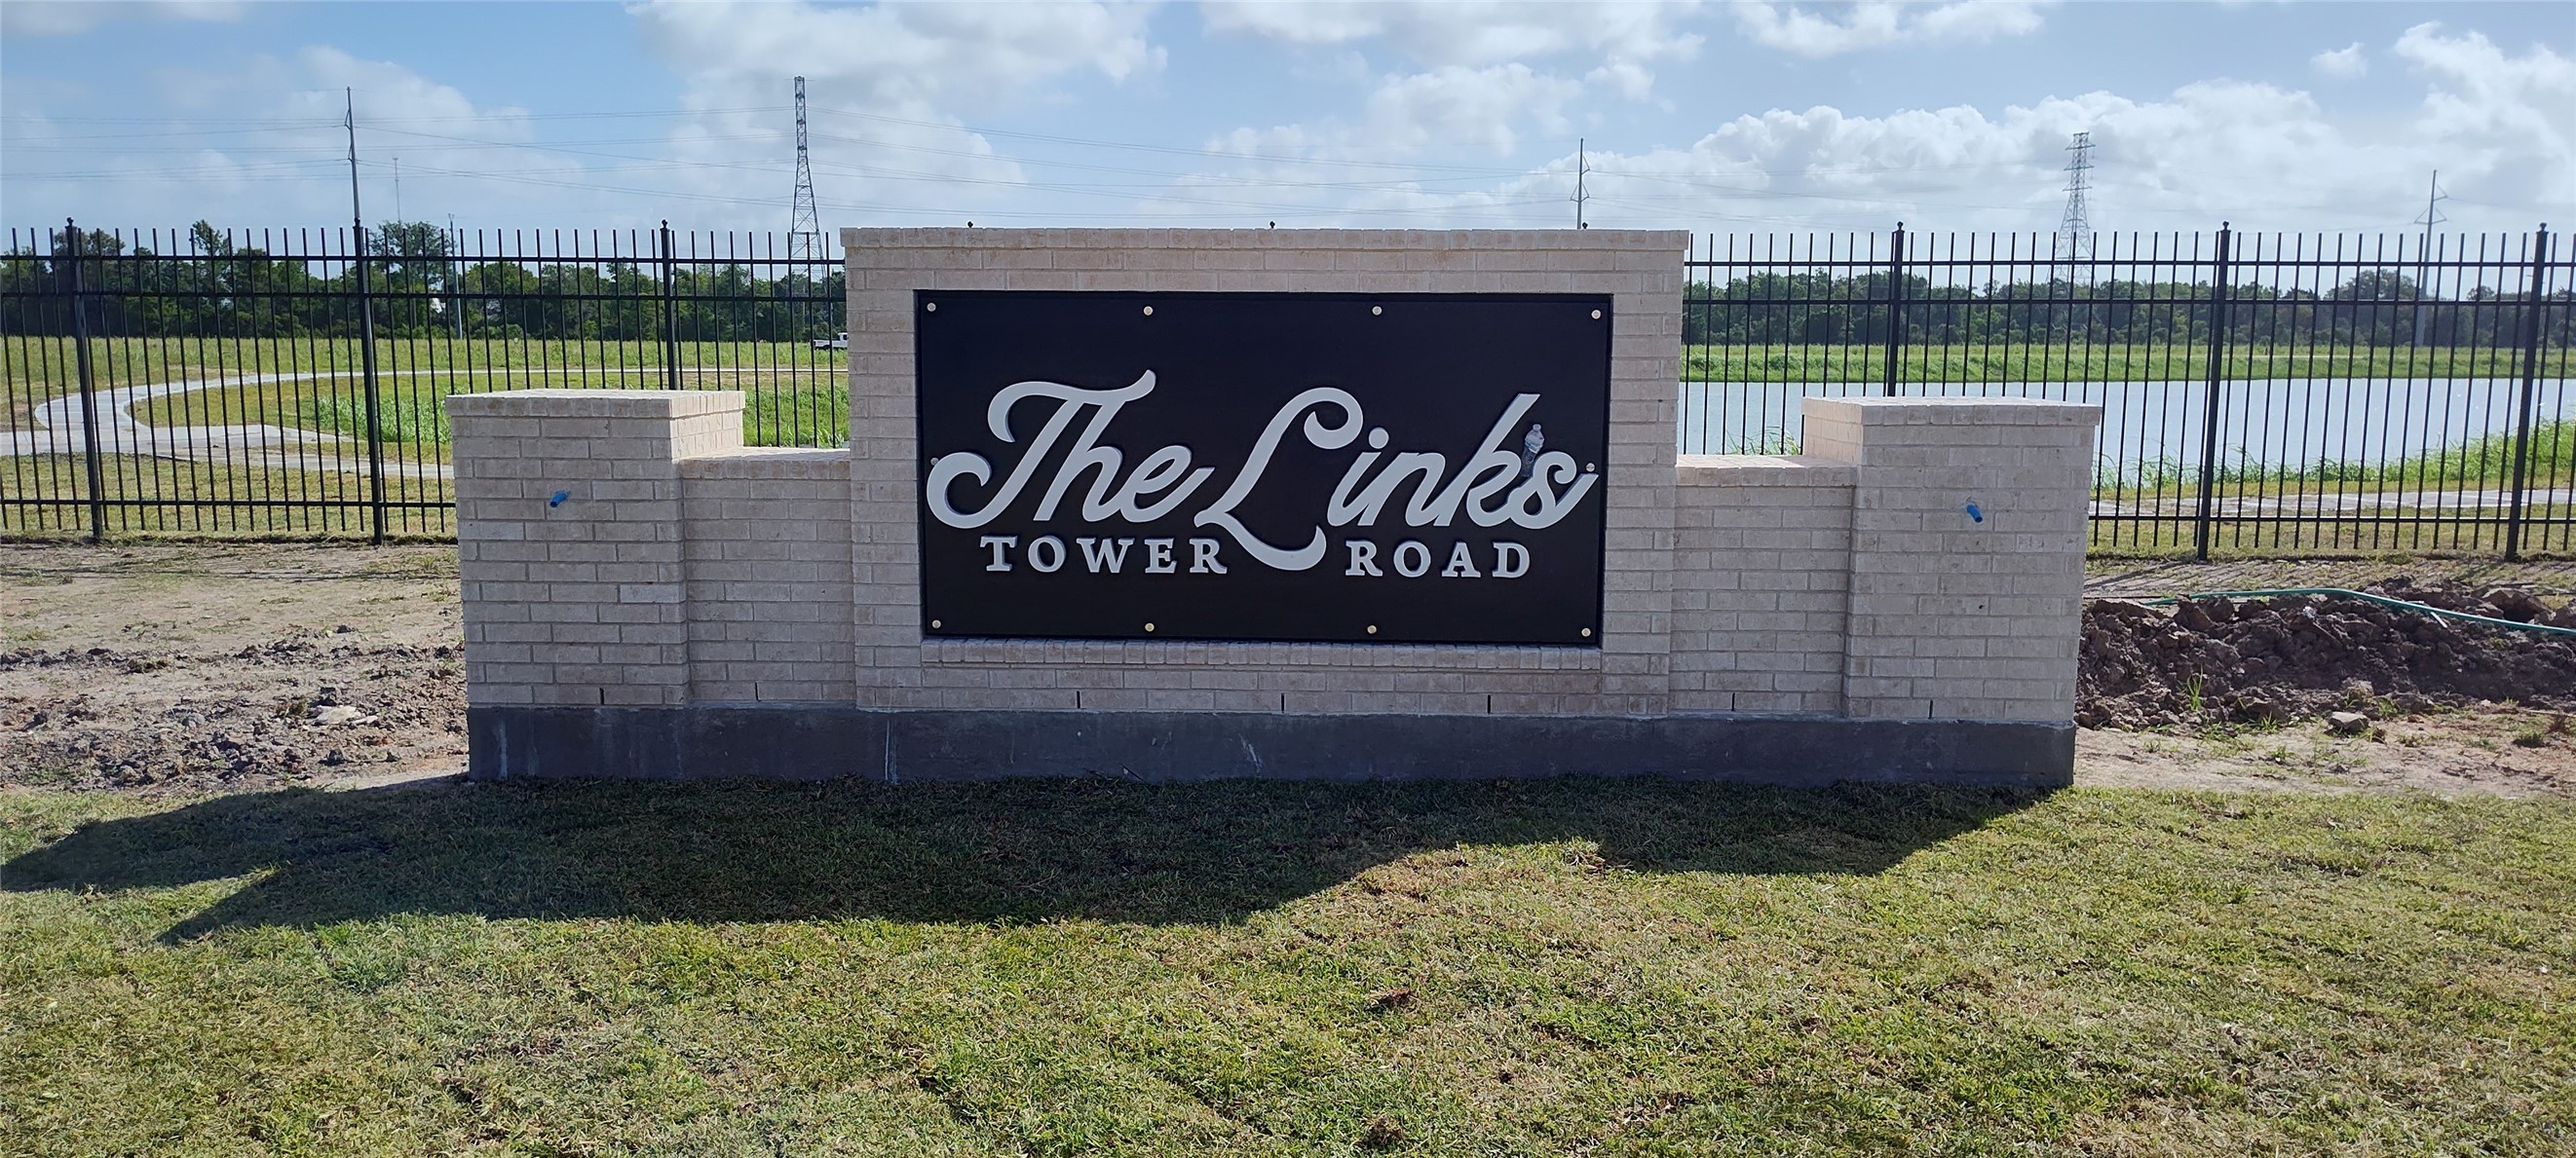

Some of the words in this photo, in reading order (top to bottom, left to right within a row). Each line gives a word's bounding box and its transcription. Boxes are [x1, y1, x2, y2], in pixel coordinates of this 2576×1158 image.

[927, 369, 1214, 529] The
[1194, 387, 1599, 571] Links
[979, 536, 1228, 575] TOWER
[1345, 541, 1532, 579] ROAD
